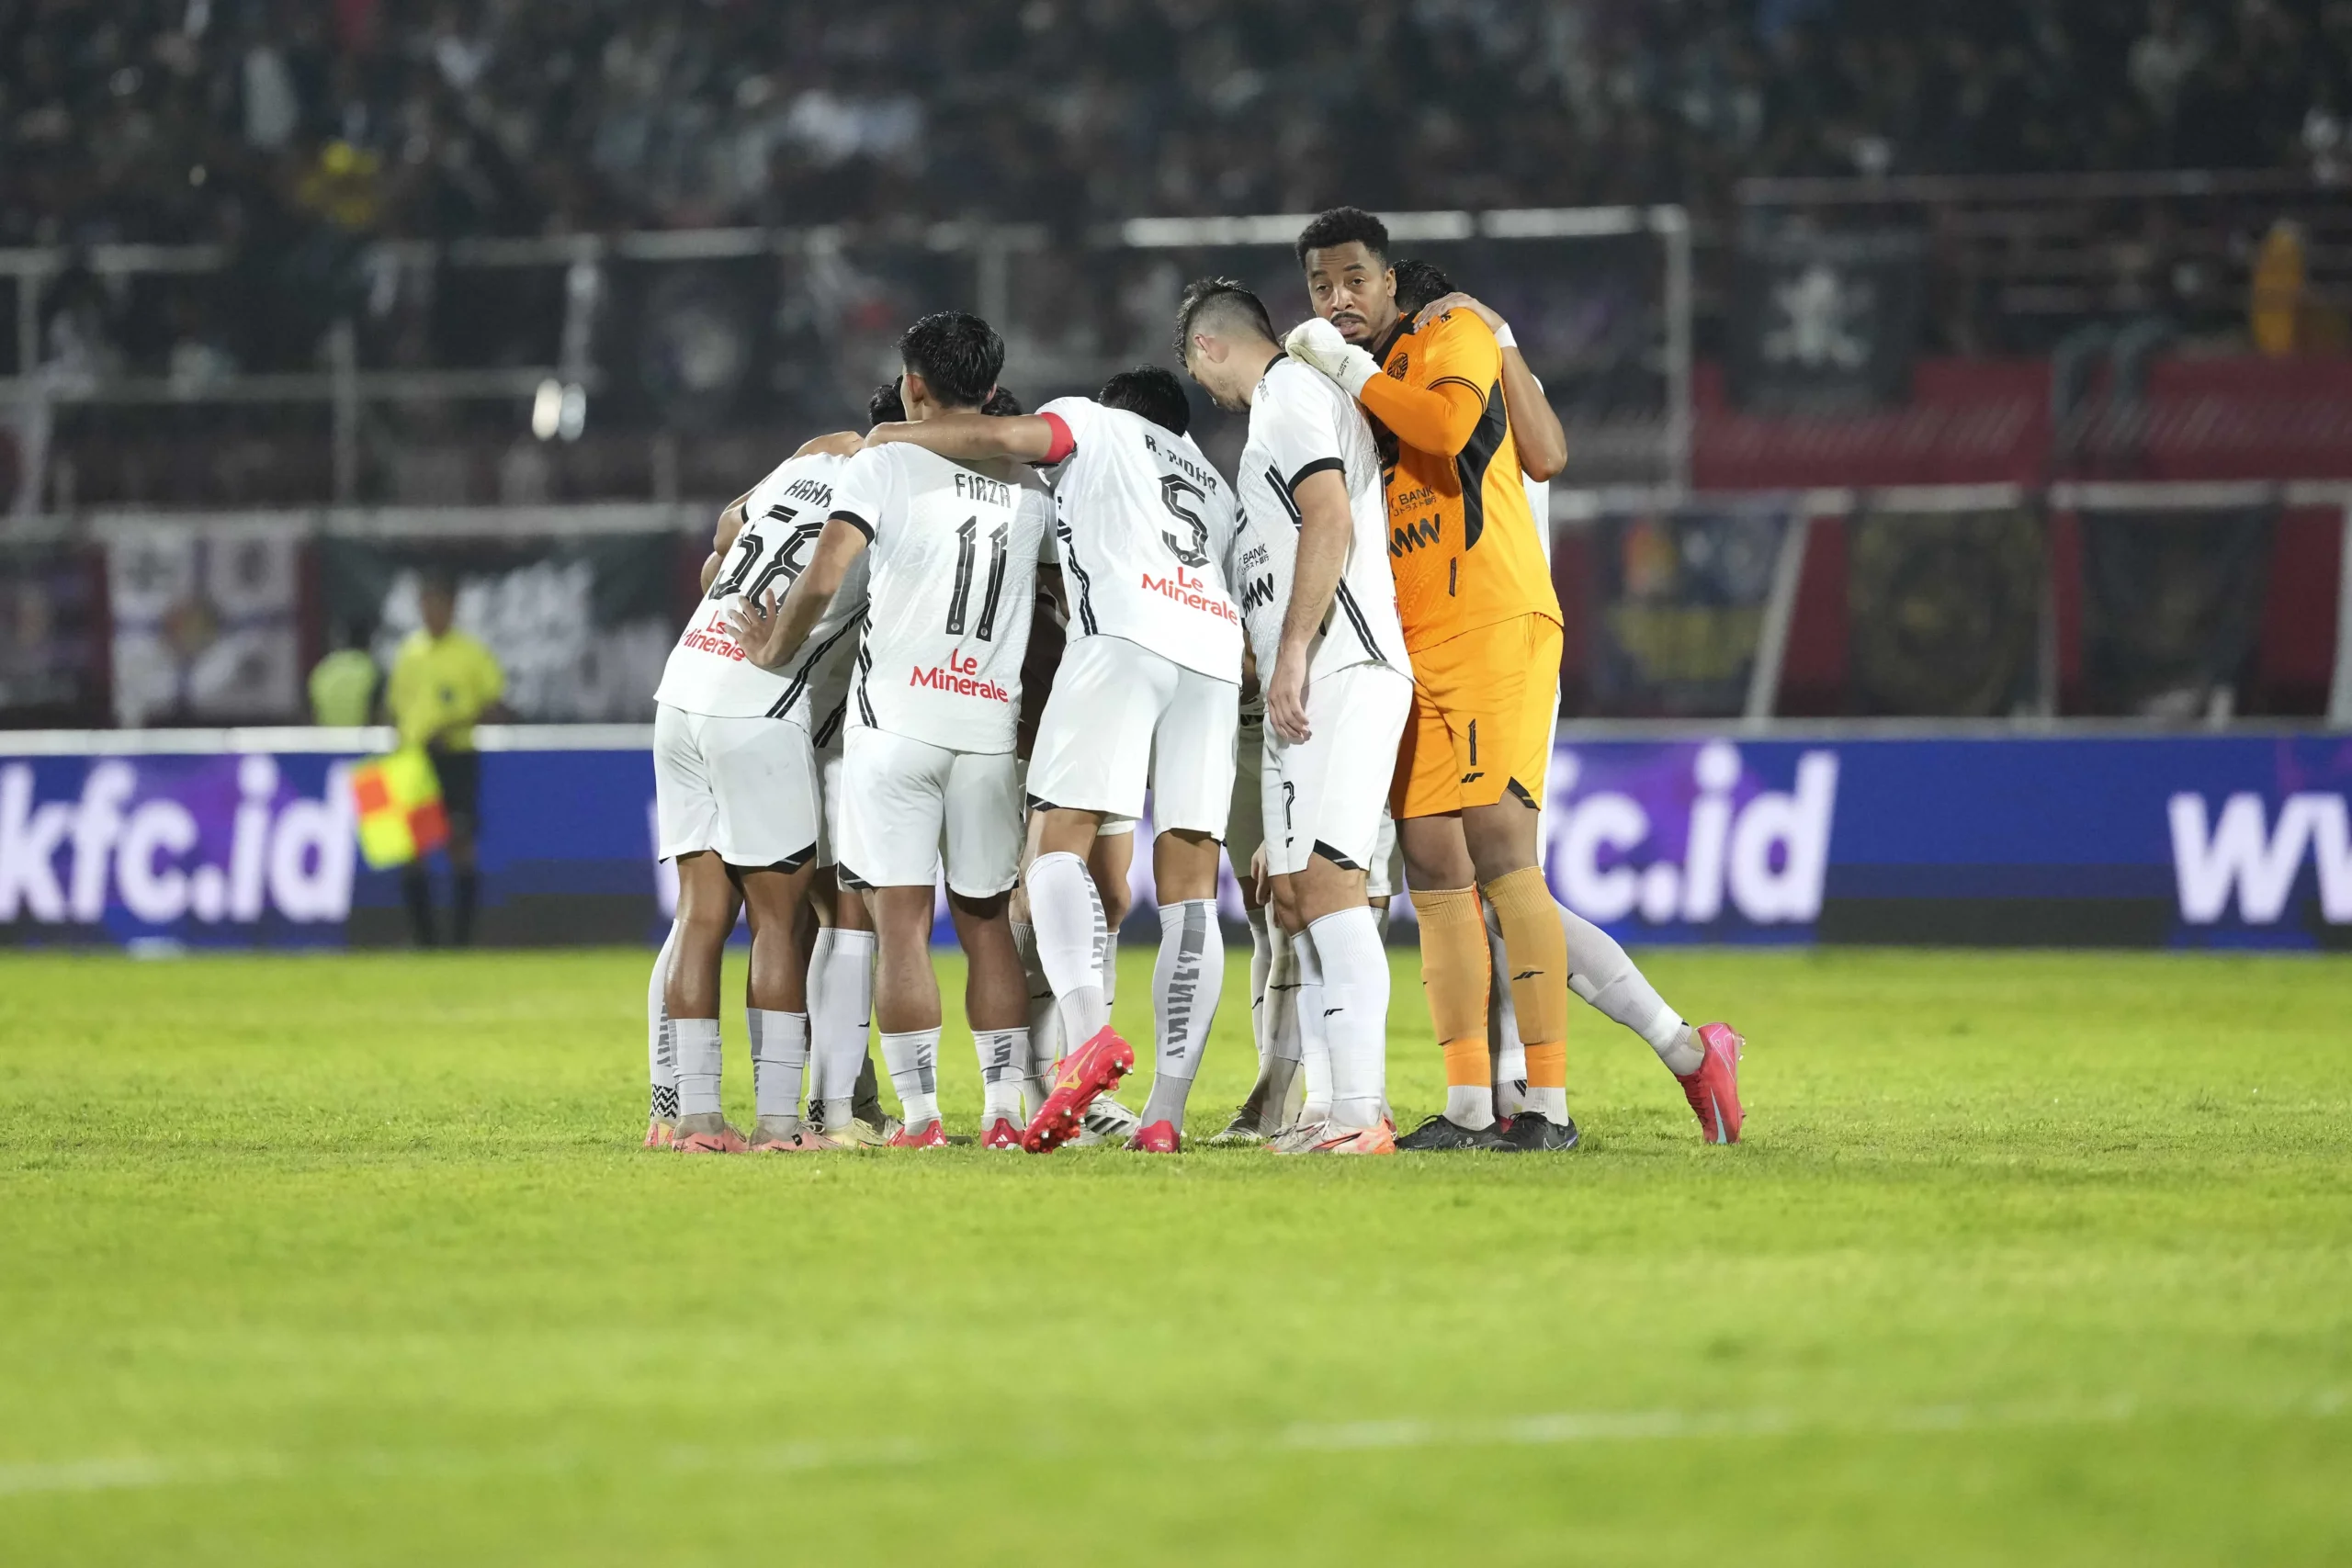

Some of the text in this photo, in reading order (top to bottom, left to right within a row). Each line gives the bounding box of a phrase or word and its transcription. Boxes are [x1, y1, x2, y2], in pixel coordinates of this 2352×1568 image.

[1145, 434, 1217, 496] R. RIDHO
[954, 473, 1012, 509] FIRZA
[1398, 485, 1434, 505] BANK
[1158, 473, 1211, 569] 5
[708, 504, 825, 619] 58
[1243, 543, 1268, 564] BANK
[945, 515, 1009, 642] 11
[1141, 573, 1238, 626] Minerale
[1178, 567, 1204, 592] Le
[910, 666, 1009, 703] Minerale
[950, 649, 978, 676] Le
[1468, 718, 1477, 767] 1
[0, 752, 356, 924] kfc.id
